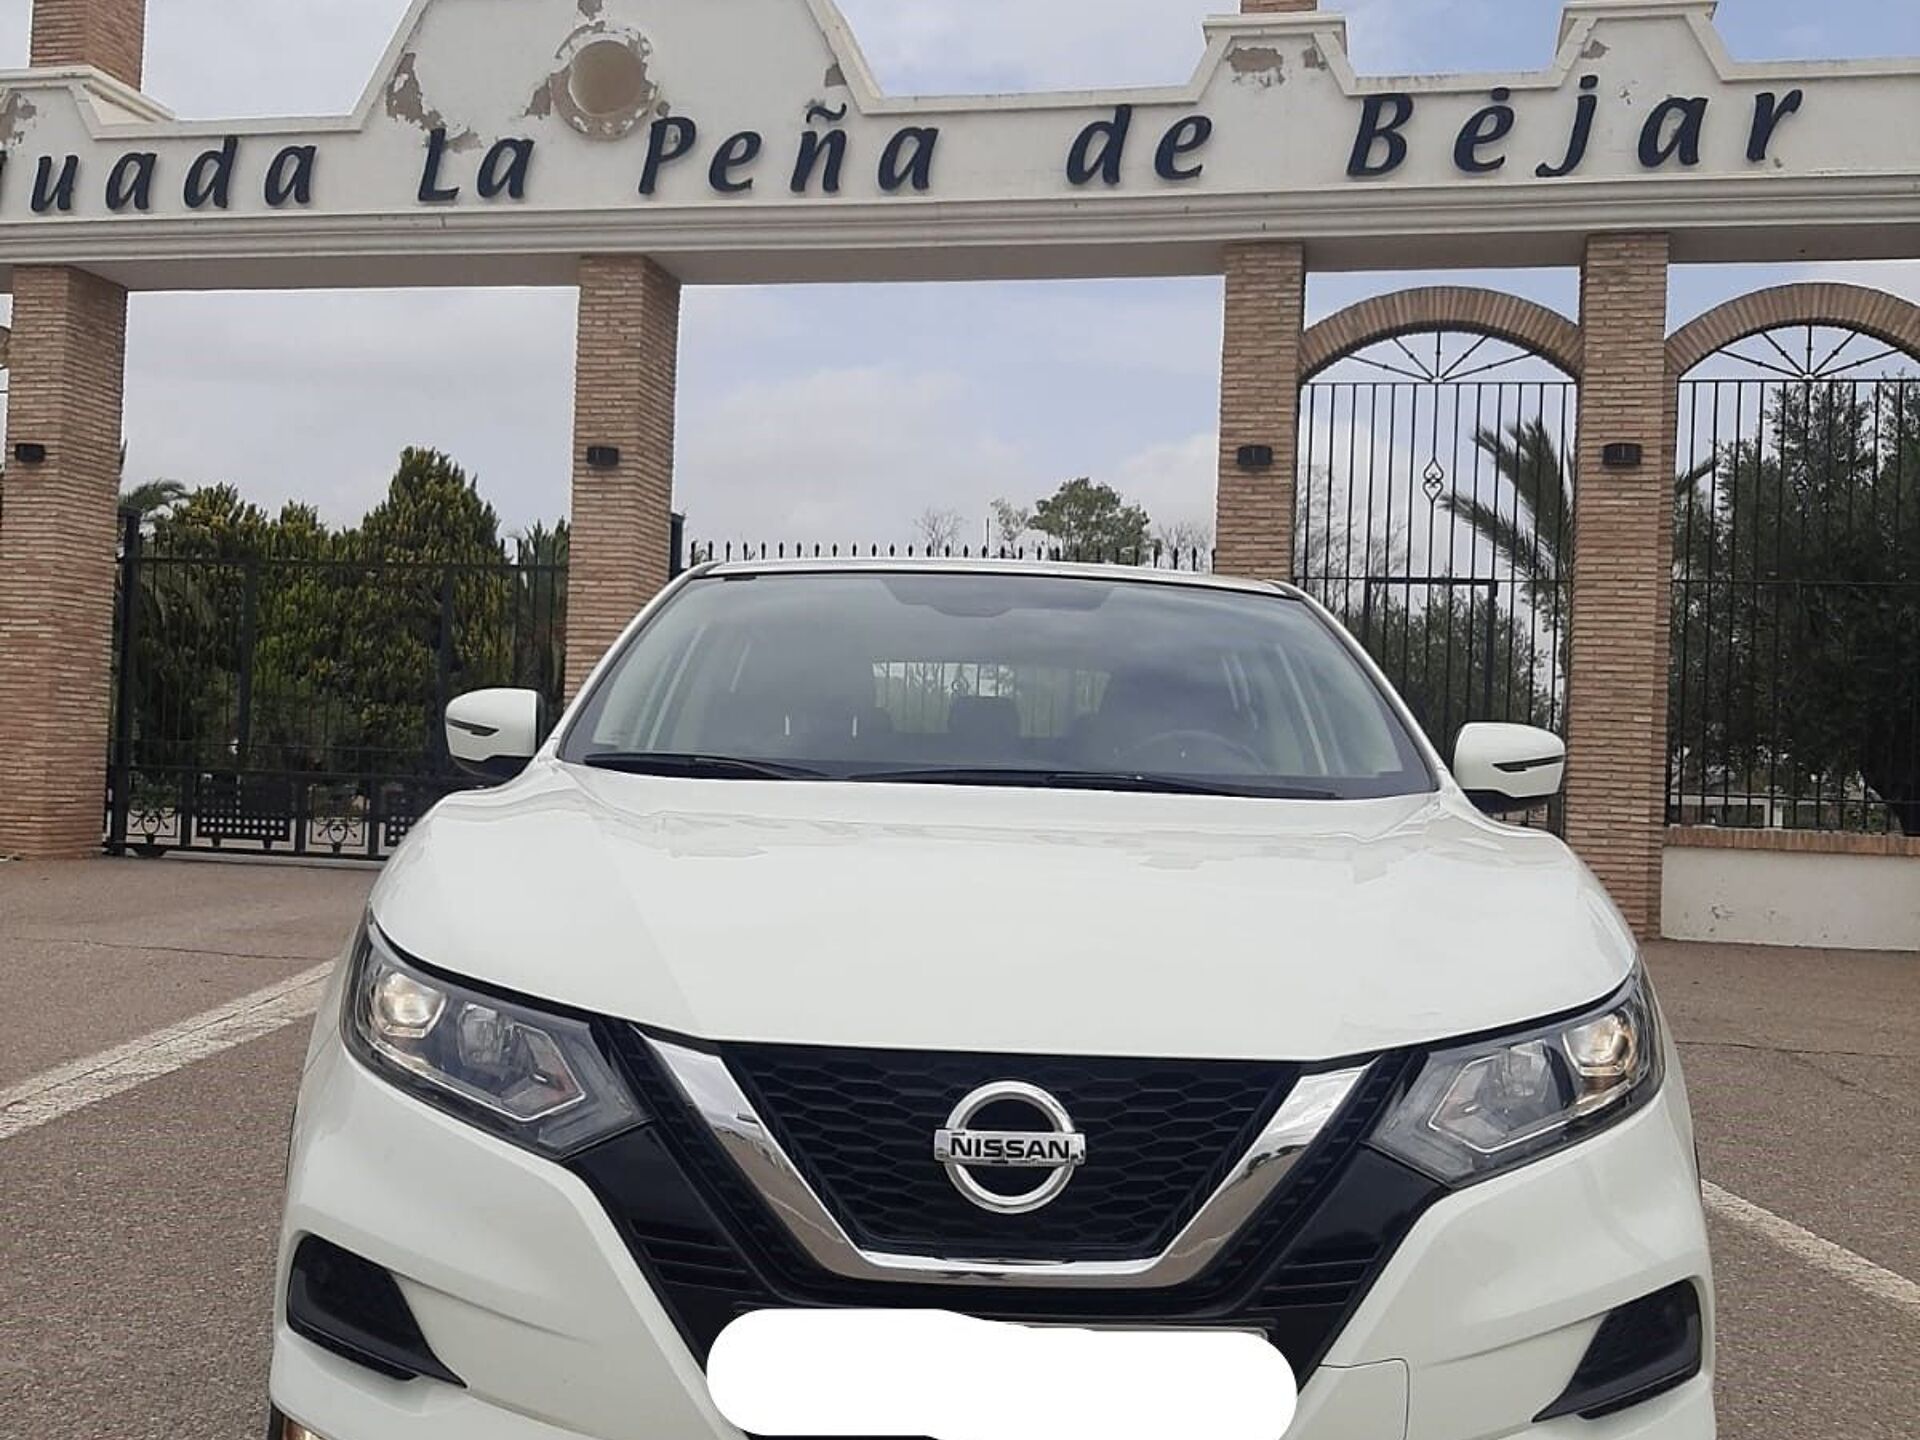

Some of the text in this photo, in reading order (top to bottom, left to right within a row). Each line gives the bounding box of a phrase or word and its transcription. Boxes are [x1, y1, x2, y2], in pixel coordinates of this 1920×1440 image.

[0, 135, 317, 213] uada
[417, 128, 535, 202] La
[638, 102, 940, 195] Peña
[1065, 103, 1213, 186] de
[951, 1137, 1070, 1159] NISSAN
